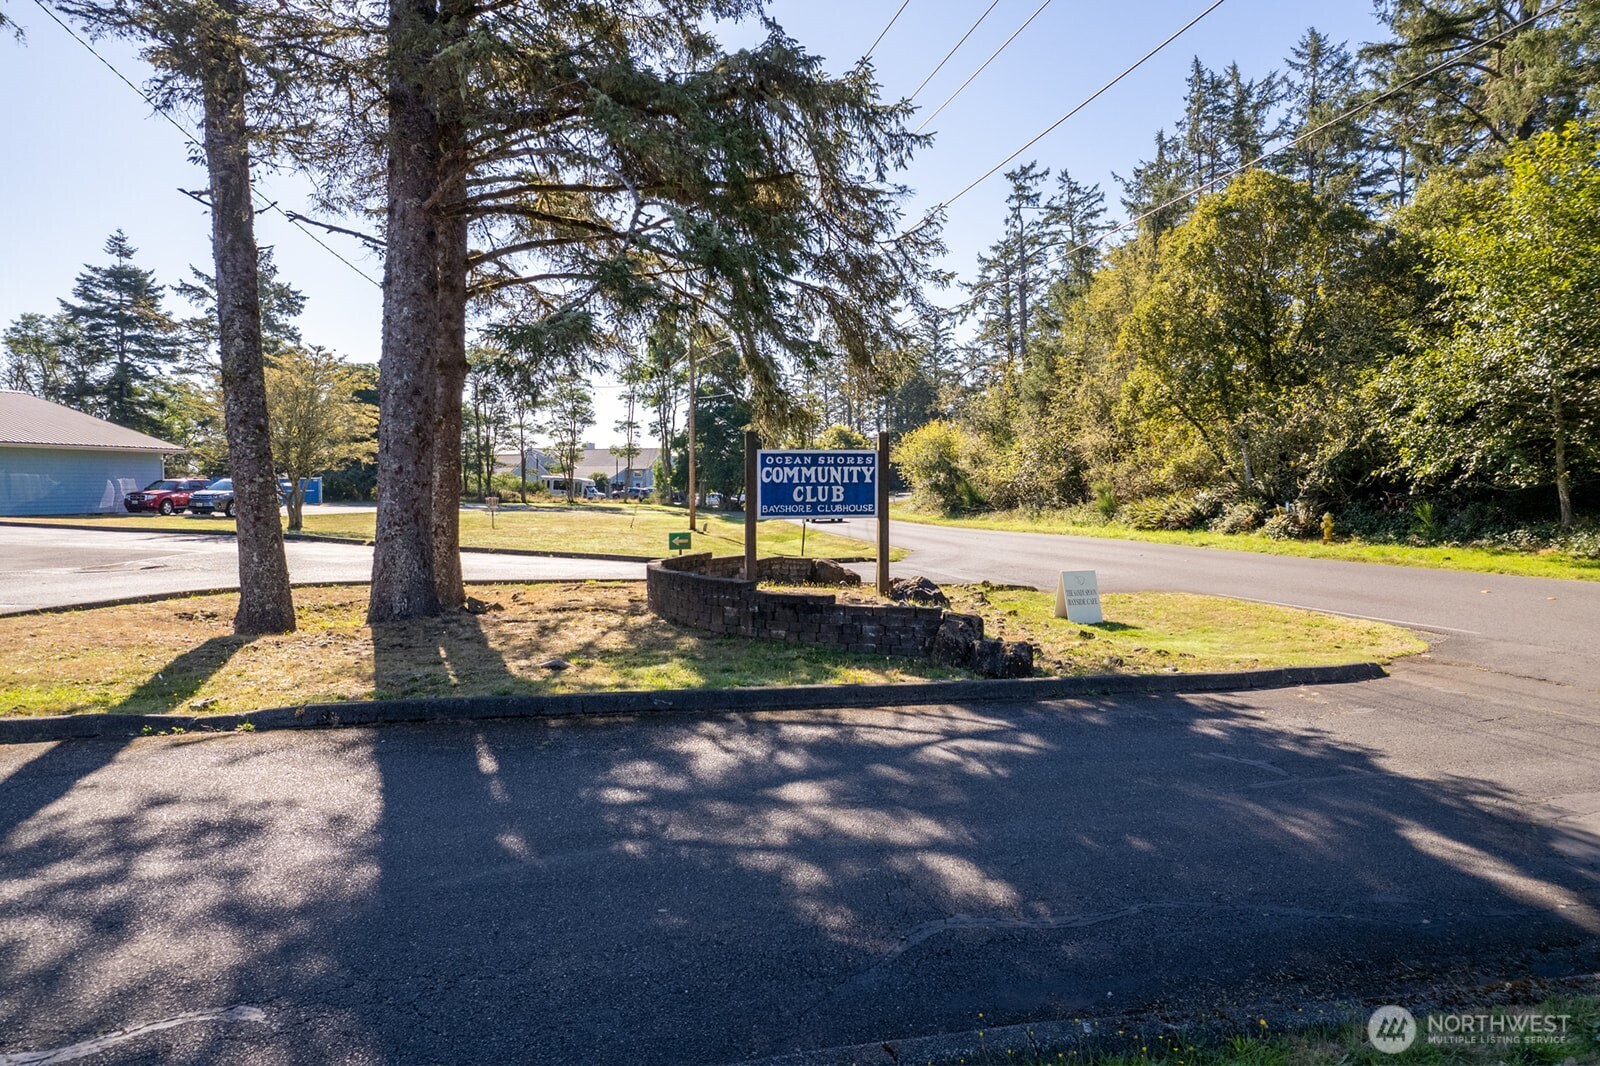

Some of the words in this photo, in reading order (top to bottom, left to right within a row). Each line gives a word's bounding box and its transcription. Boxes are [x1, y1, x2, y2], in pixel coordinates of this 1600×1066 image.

[766, 456, 812, 465] OCEAN
[817, 456, 874, 465] SHORES
[761, 466, 875, 484] COMMUNITY
[792, 485, 845, 503] CLUB
[762, 504, 813, 513] BAYSHORE
[817, 504, 875, 513] CLUBHOUSE
